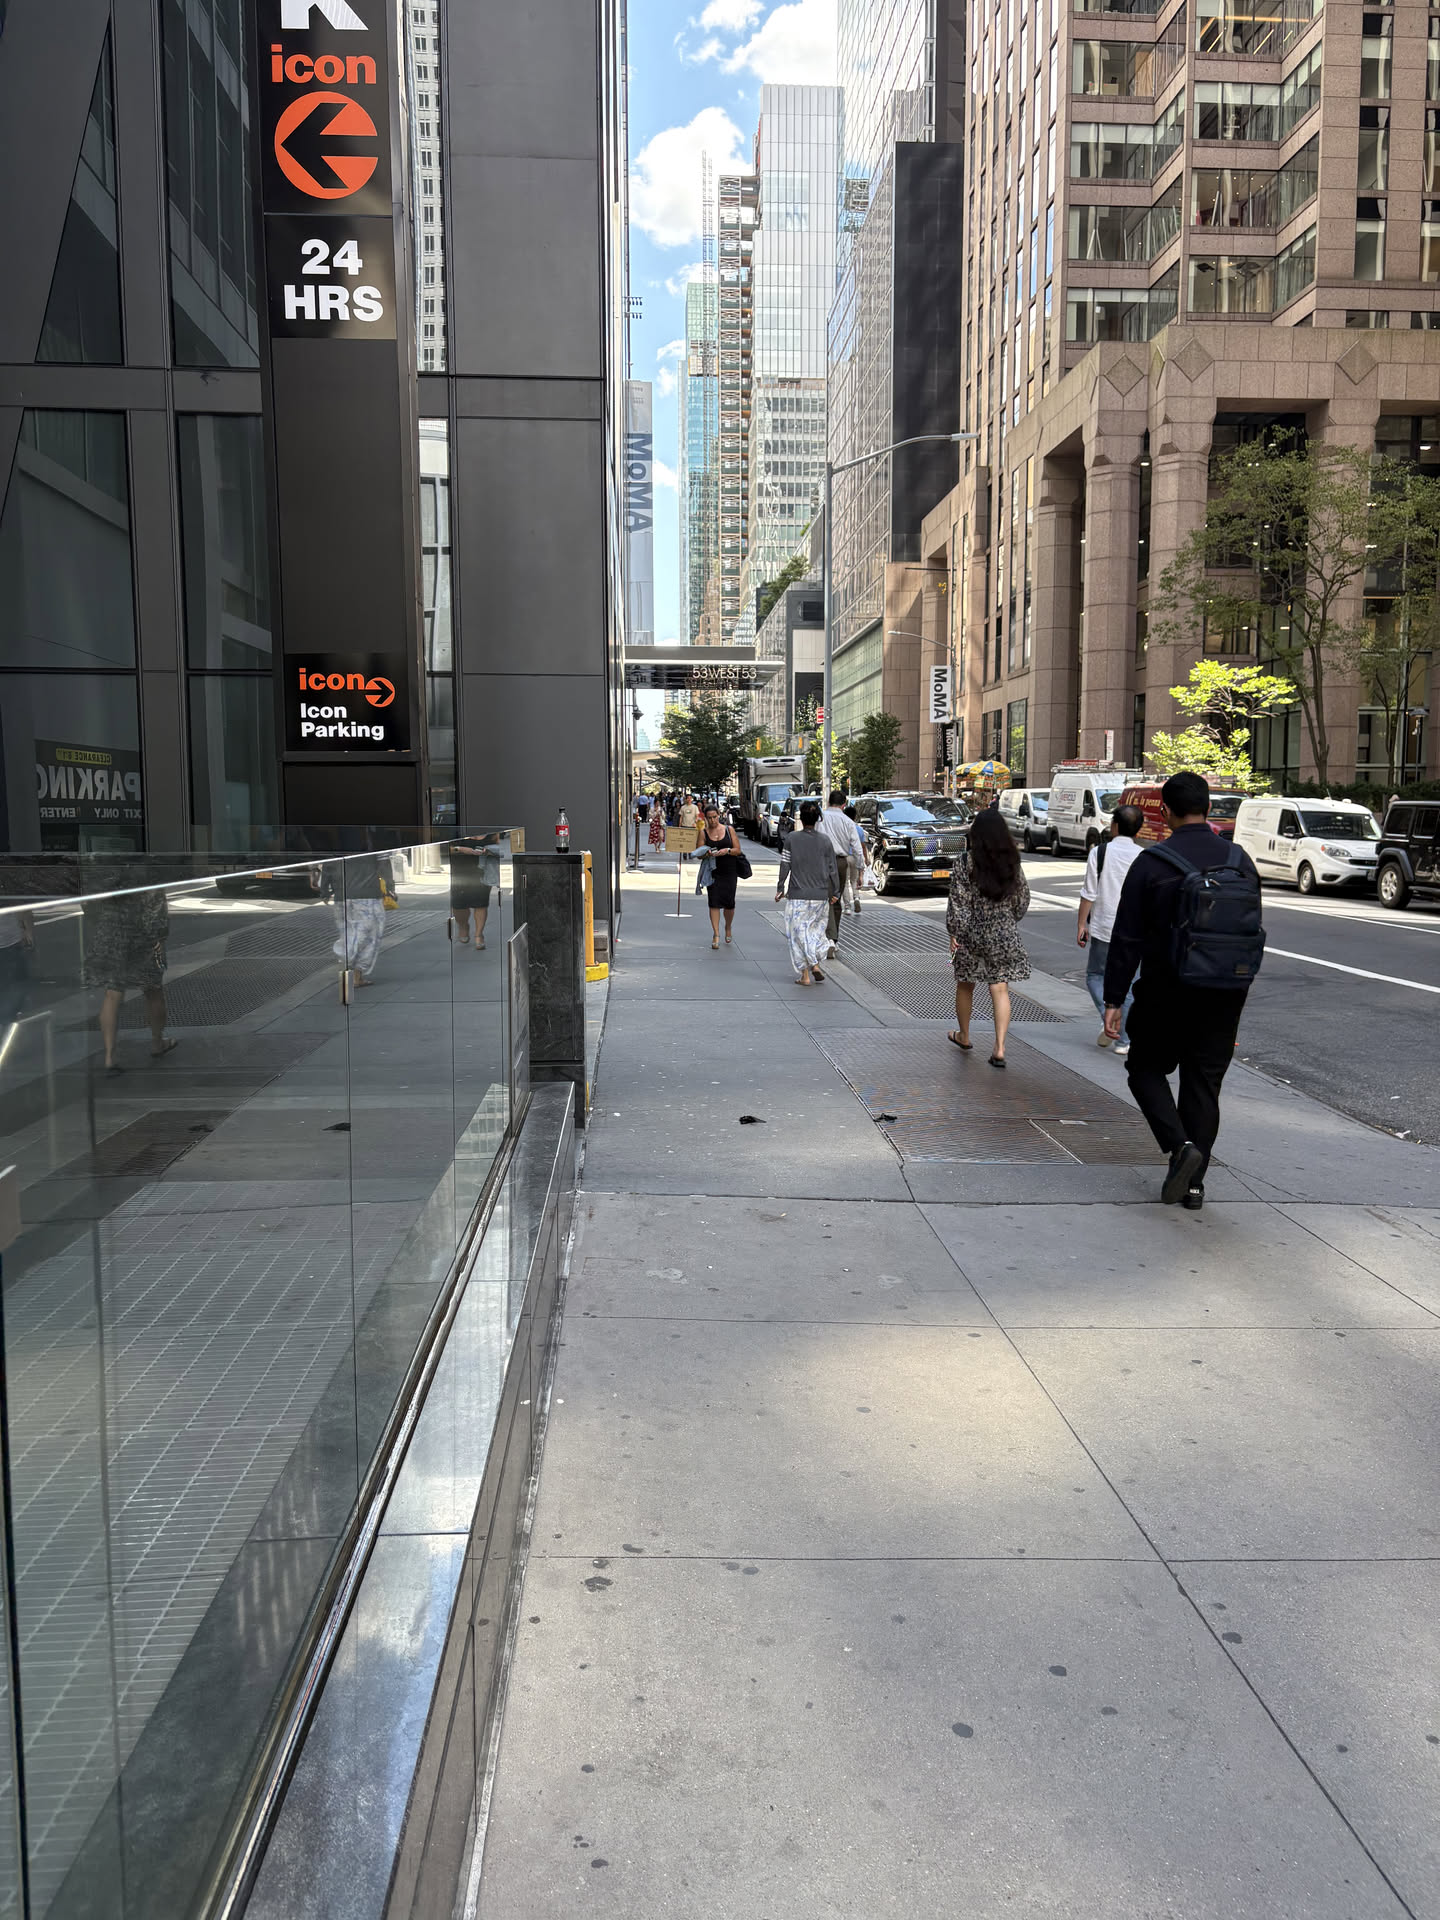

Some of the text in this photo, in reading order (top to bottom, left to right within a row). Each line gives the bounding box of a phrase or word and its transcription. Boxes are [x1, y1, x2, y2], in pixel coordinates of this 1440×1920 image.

[271, 43, 377, 84] icon
[301, 238, 363, 276] 24
[284, 284, 384, 322] HRS
[624, 432, 653, 534] MoMA
[299, 667, 365, 691] icon
[933, 668, 948, 720] MoMA
[300, 702, 348, 719] Icon
[301, 721, 385, 741] Parking
